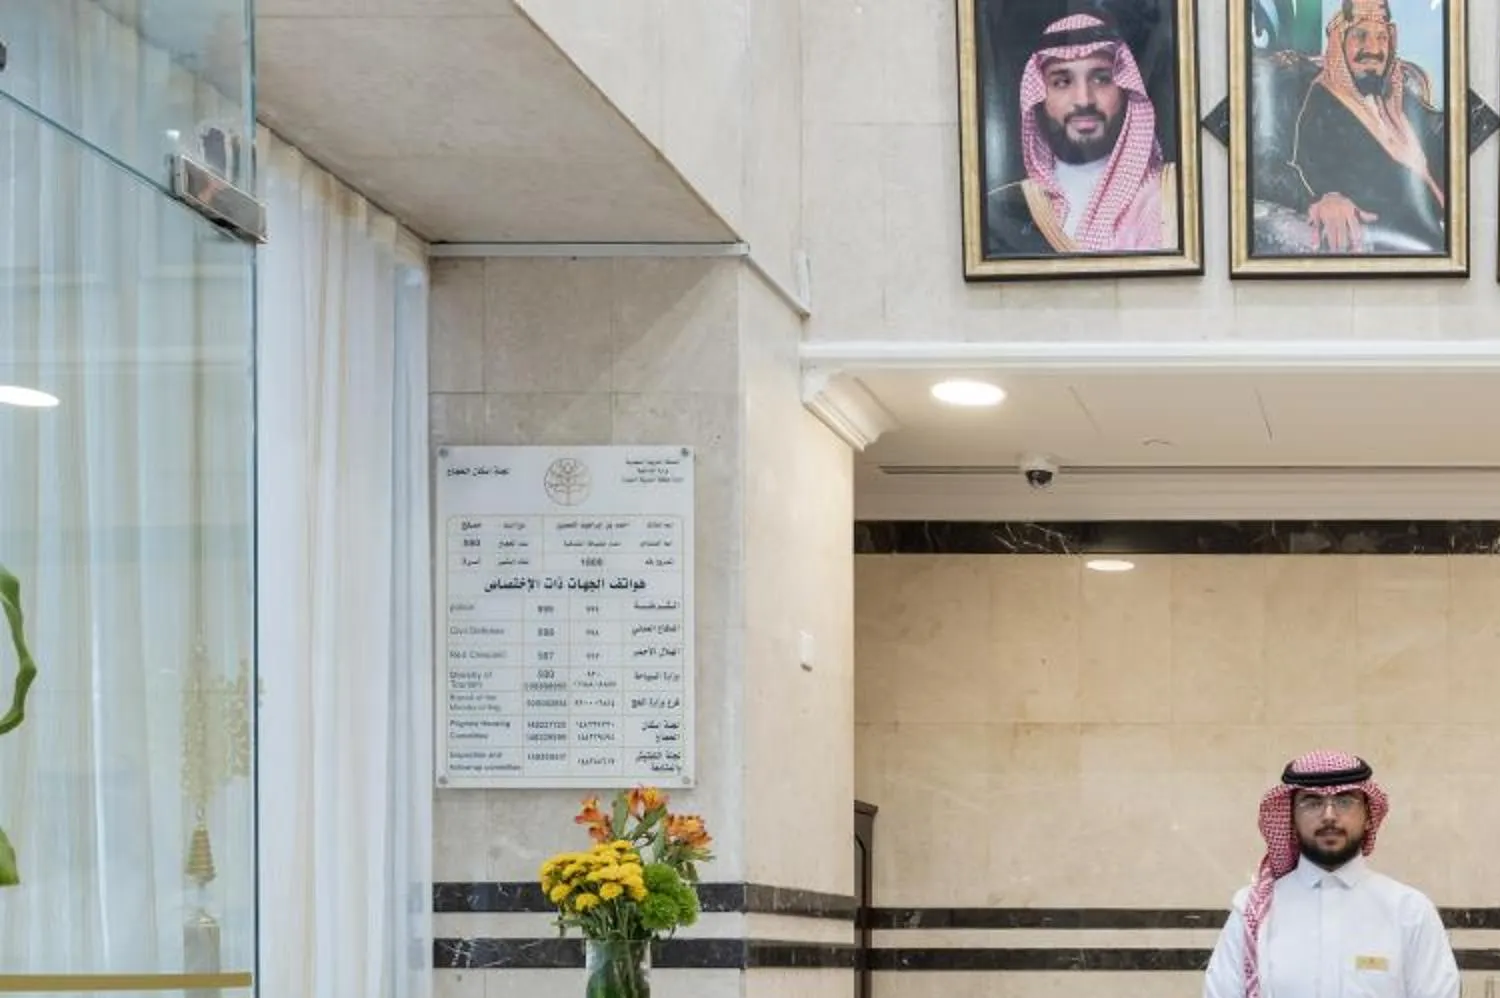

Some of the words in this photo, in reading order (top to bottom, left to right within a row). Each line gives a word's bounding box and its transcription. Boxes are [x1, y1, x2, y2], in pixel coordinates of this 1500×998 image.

[544, 575, 563, 589] ذات
[567, 575, 605, 592] الجهات
[609, 576, 647, 592] هواتف
